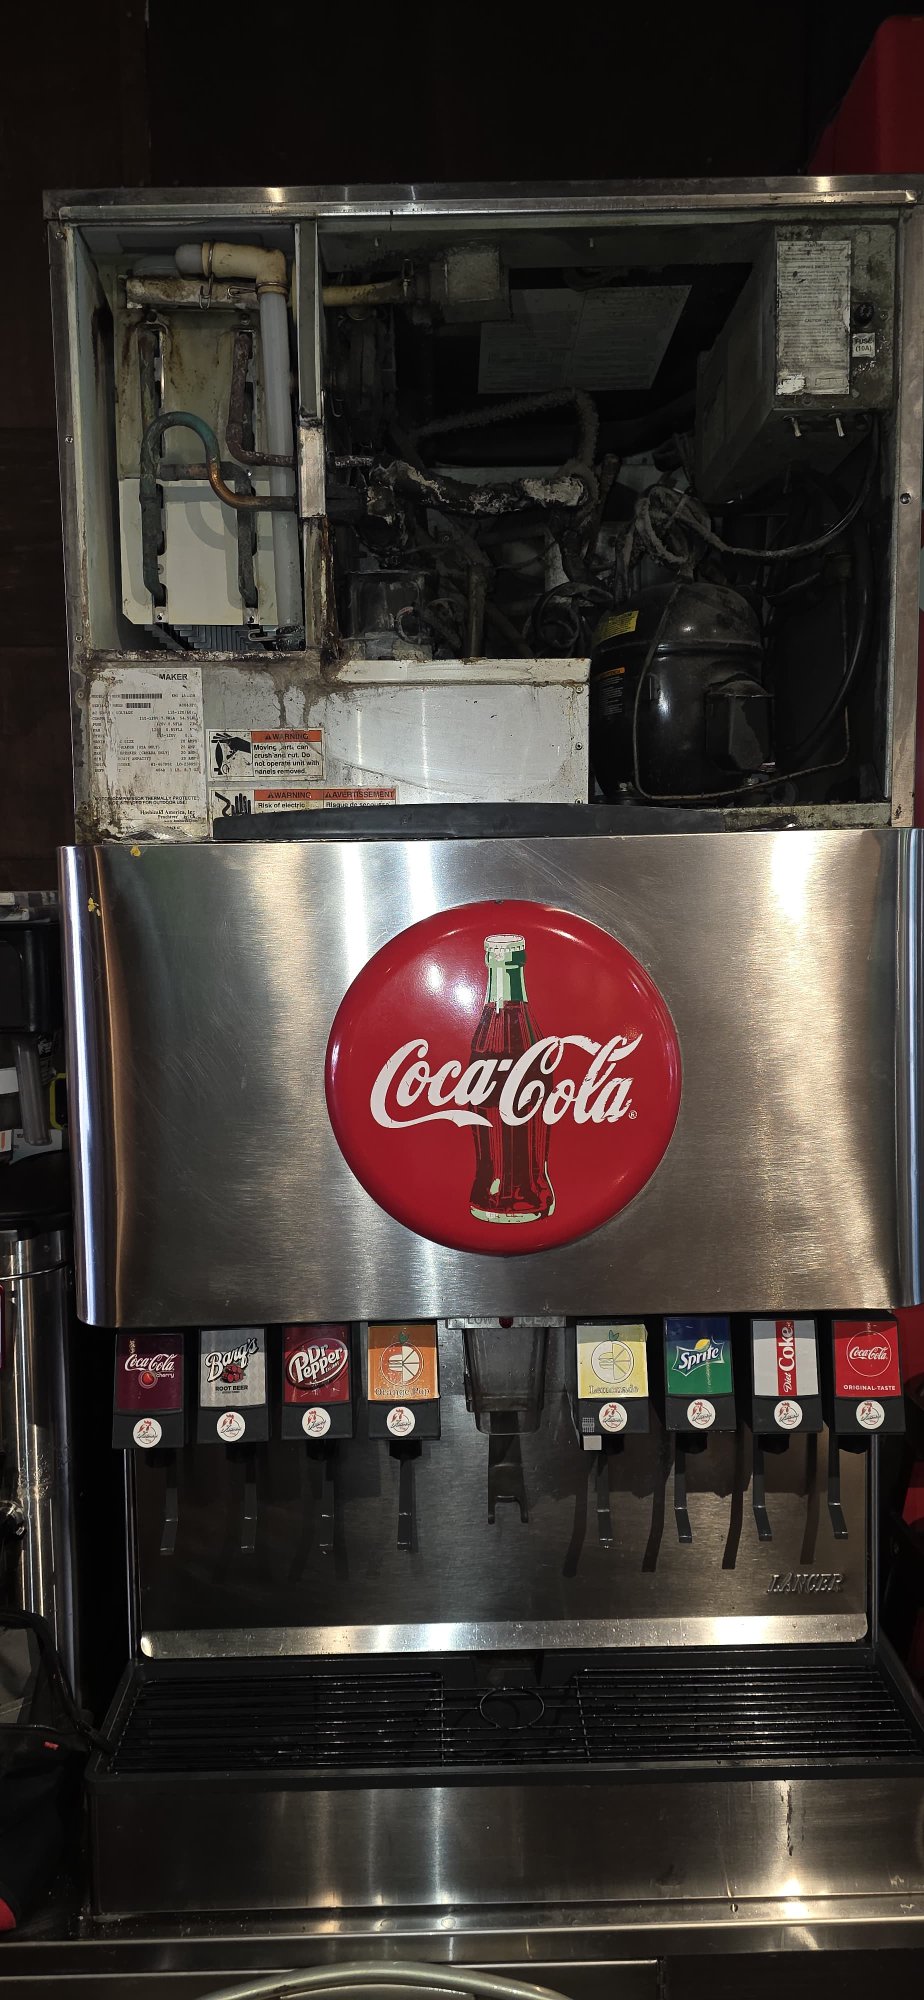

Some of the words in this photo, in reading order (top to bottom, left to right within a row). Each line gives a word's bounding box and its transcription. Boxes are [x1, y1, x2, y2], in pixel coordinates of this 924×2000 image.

[370, 1033, 643, 1128] Coca-Cola
[308, 1344, 328, 1365] Dr
[678, 1345, 719, 1371] Sprite
[778, 1327, 795, 1372] Coke
[849, 1346, 889, 1360] Coca-Cola
[125, 1353, 178, 1371] Coca-Cola
[205, 1338, 259, 1383] Barq's
[294, 1347, 343, 1384] Pepper
[156, 1371, 175, 1379] cherry
[783, 1372, 792, 1393] Diet
[375, 1388, 408, 1398] Orange
[588, 1385, 639, 1395] Lemonade
[767, 1572, 844, 1592] LANCER
